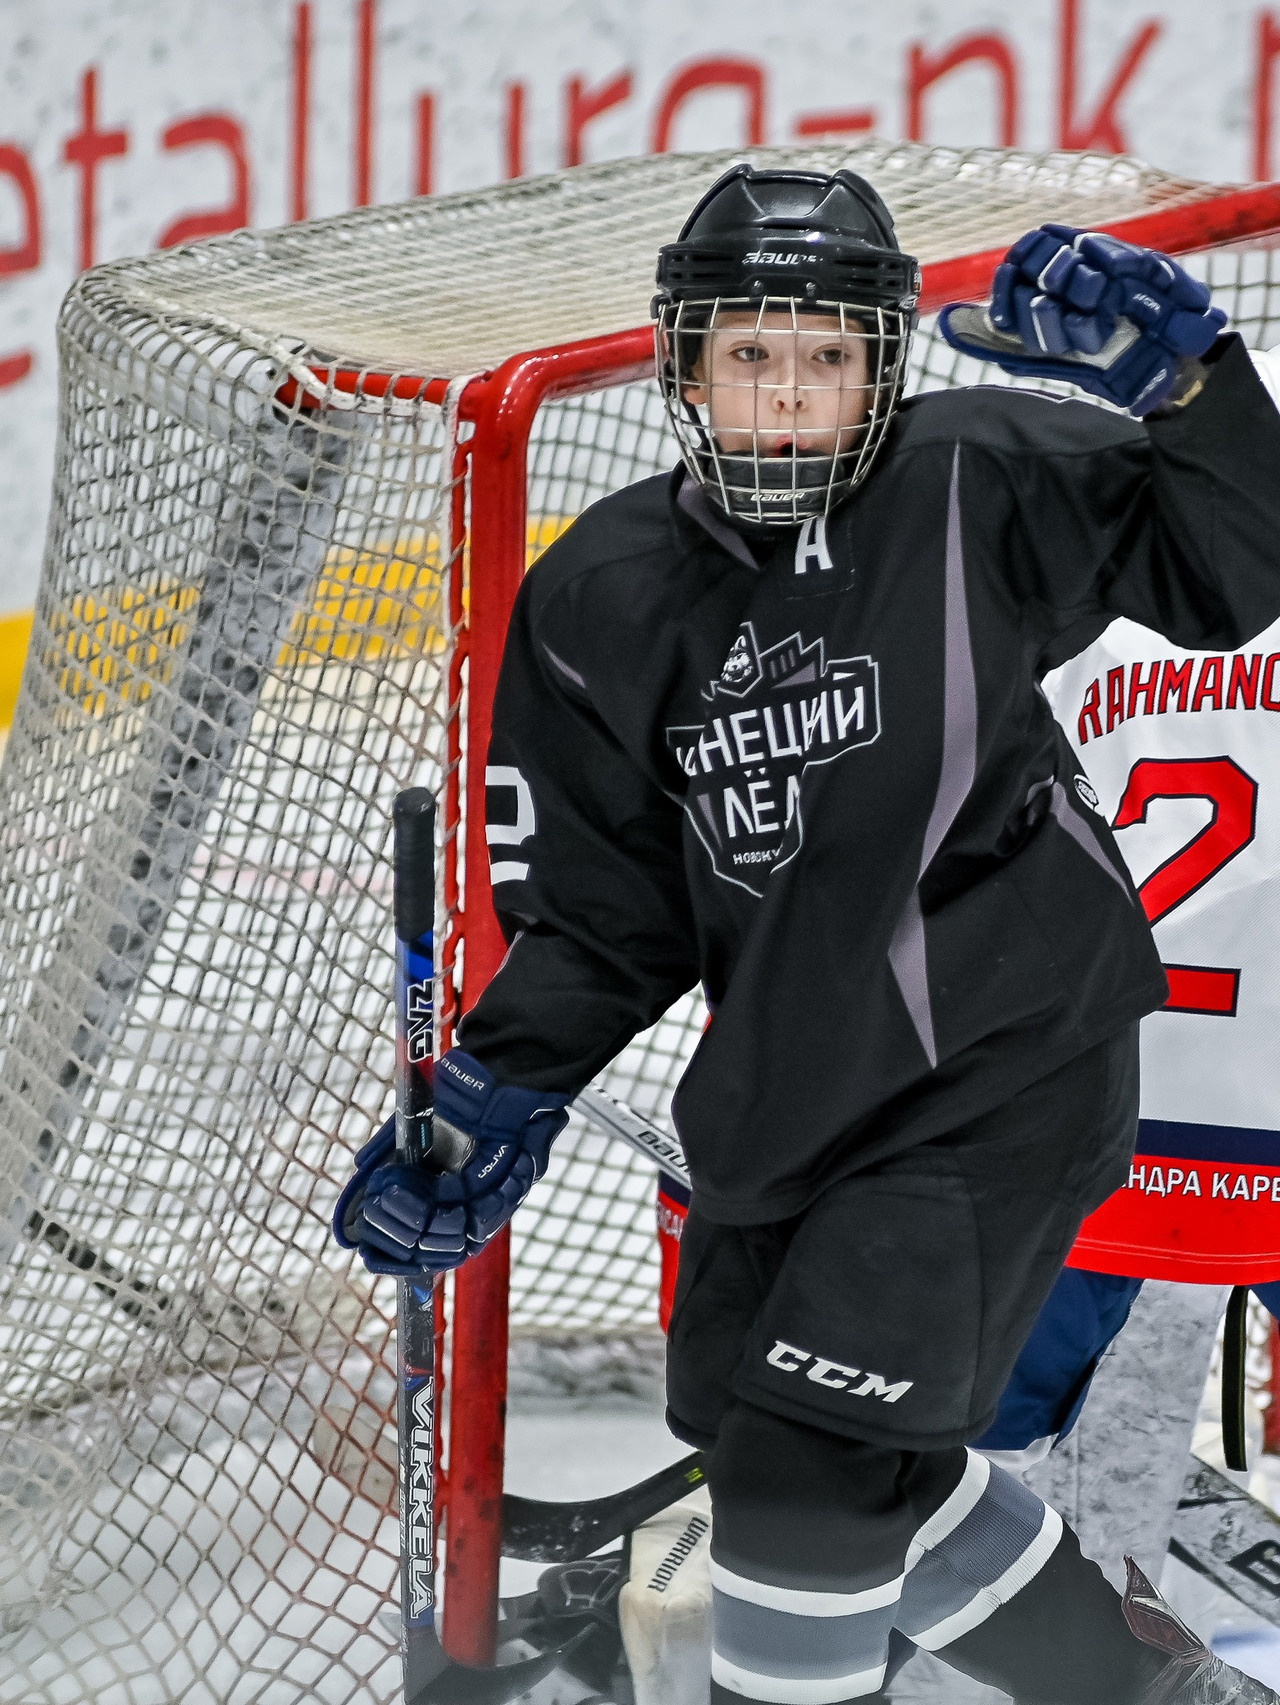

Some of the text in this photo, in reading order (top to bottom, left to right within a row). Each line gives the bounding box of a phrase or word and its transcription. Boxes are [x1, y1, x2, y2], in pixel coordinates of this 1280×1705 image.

[794, 515, 834, 575] A
[1111, 754, 1260, 1018] 2
[440, 1056, 485, 1092] BAUER
[477, 1144, 509, 1179] VAPOR
[1121, 1163, 1202, 1198] НДРА
[766, 1340, 914, 1403] CCM
[409, 1376, 435, 1619] VIKKELA
[646, 1516, 709, 1593] WARRIOR
